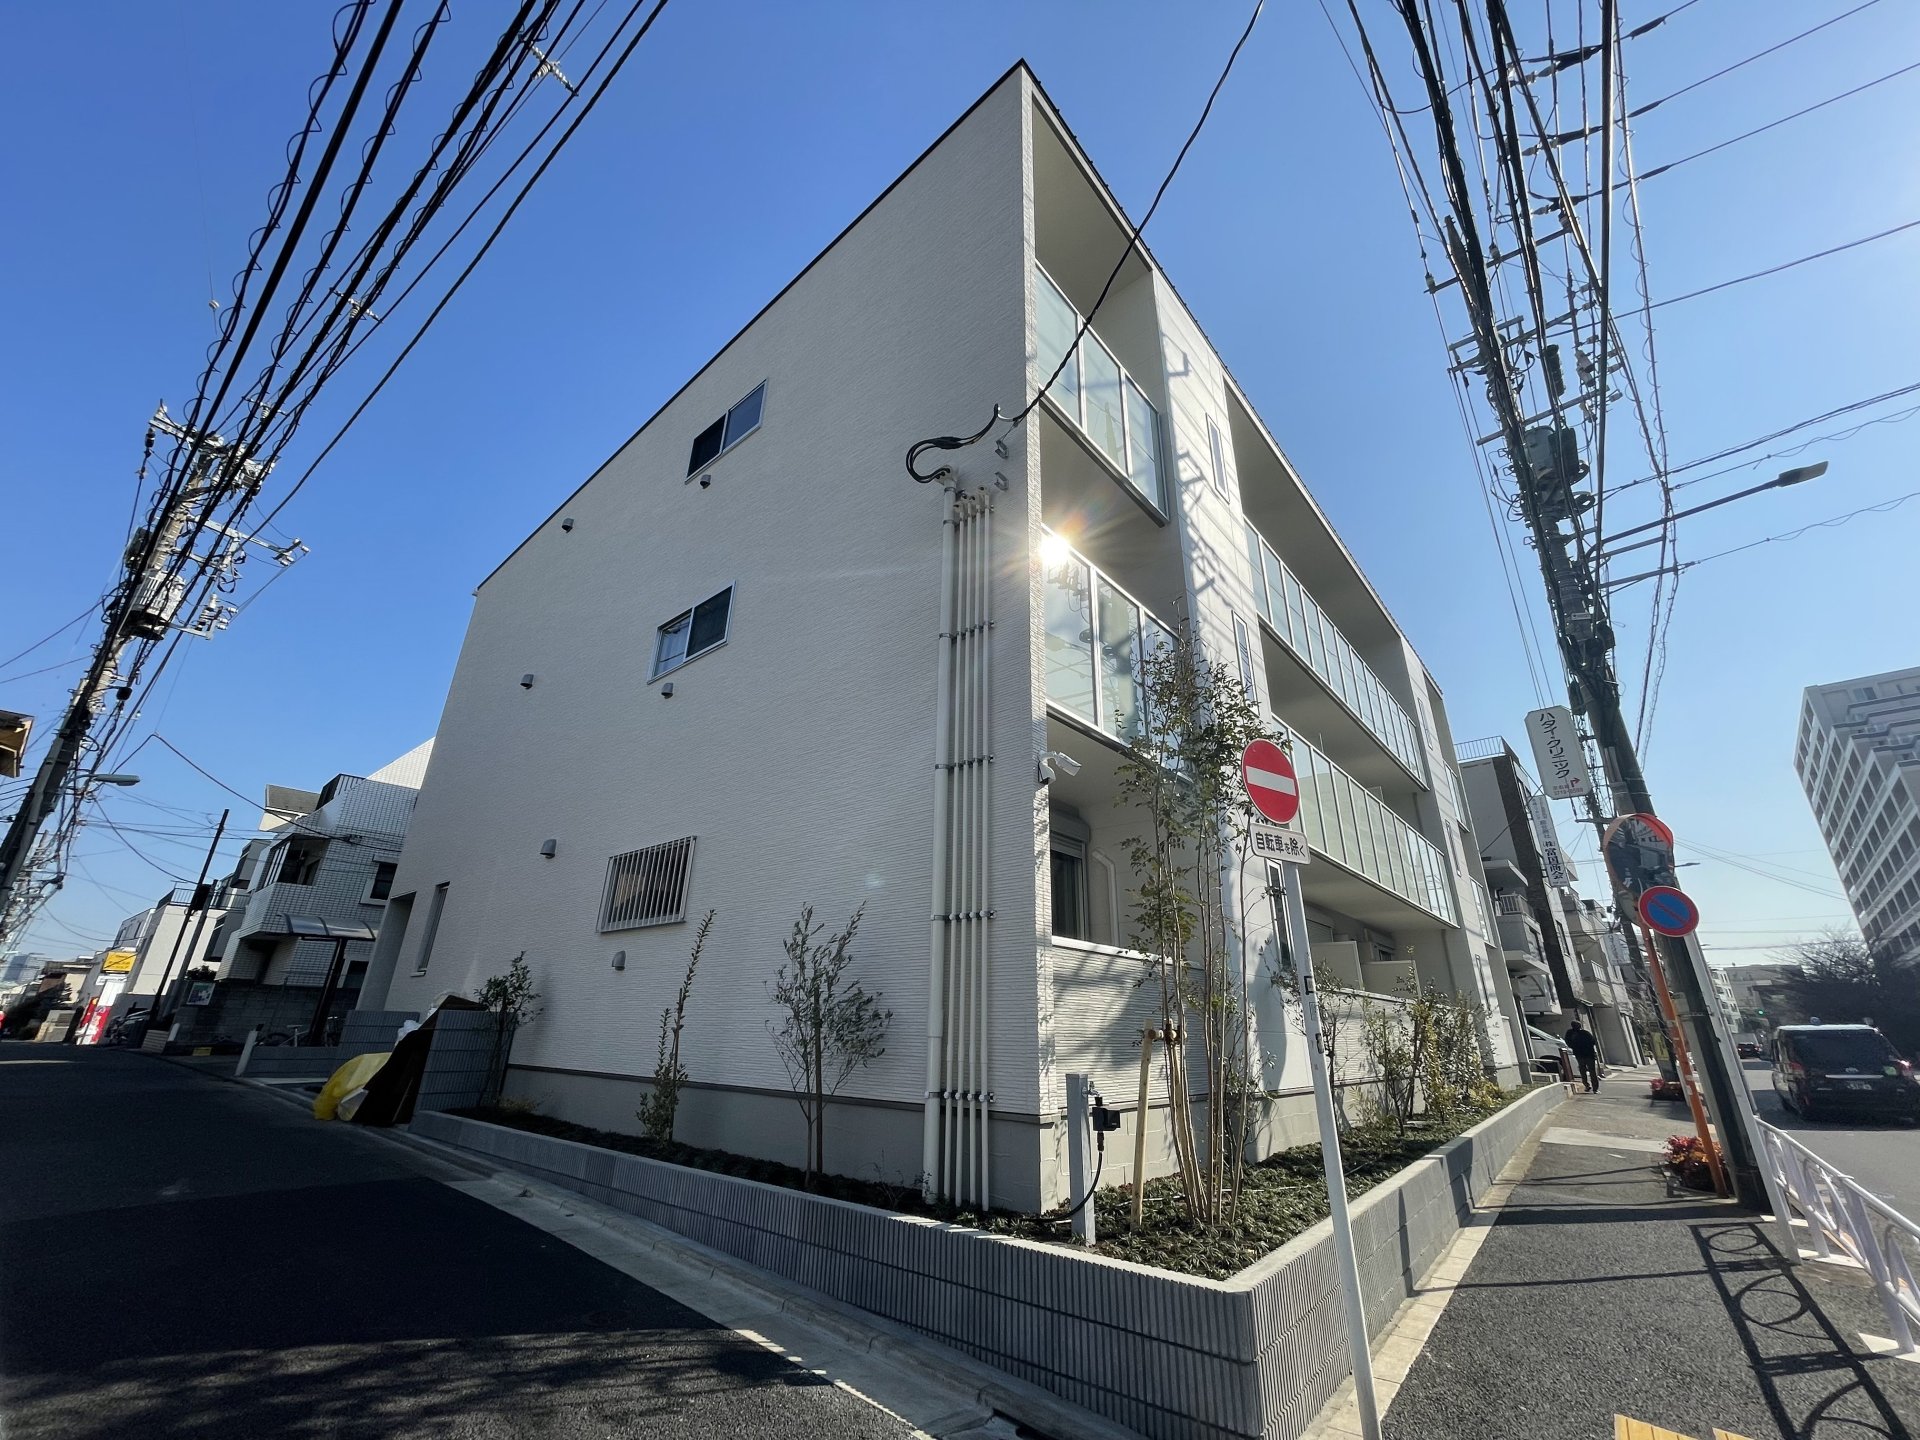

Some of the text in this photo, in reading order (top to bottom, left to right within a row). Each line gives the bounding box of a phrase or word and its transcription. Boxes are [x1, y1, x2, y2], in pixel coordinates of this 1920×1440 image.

[1256, 832, 1305, 857] 自転車を除く
